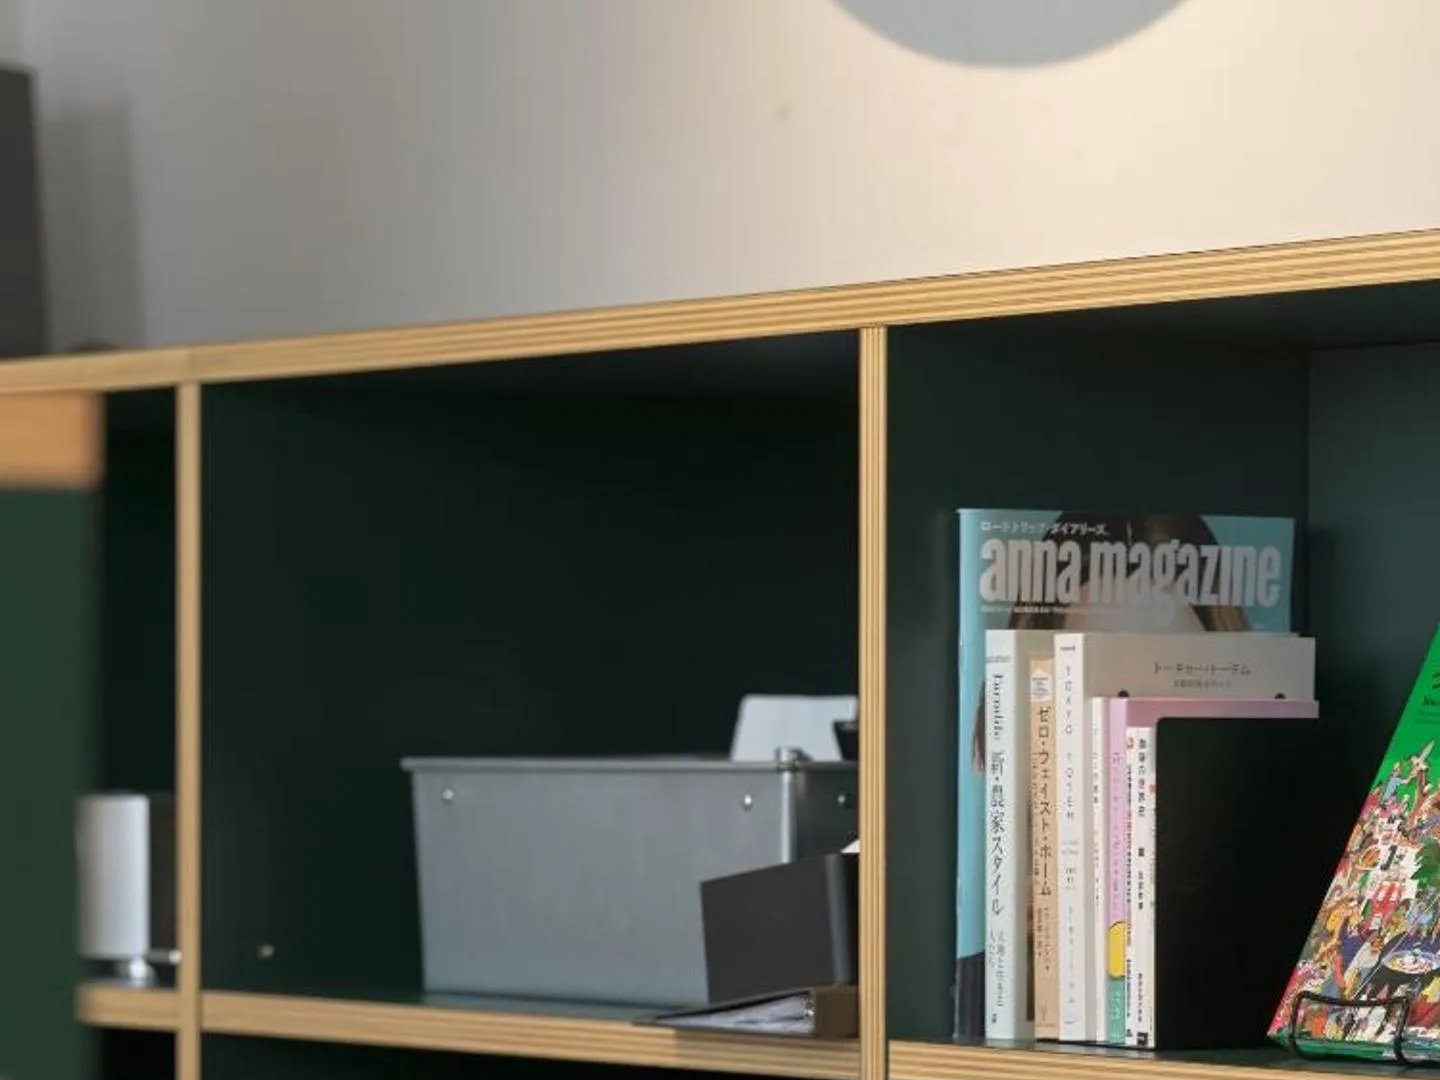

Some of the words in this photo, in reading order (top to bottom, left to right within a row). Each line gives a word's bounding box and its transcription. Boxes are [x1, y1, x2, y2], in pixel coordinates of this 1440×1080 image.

[979, 537, 1082, 605] anna
[1090, 538, 1282, 608] magazine
[1037, 706, 1052, 896] ゼロ・ウェイスト・ホーム
